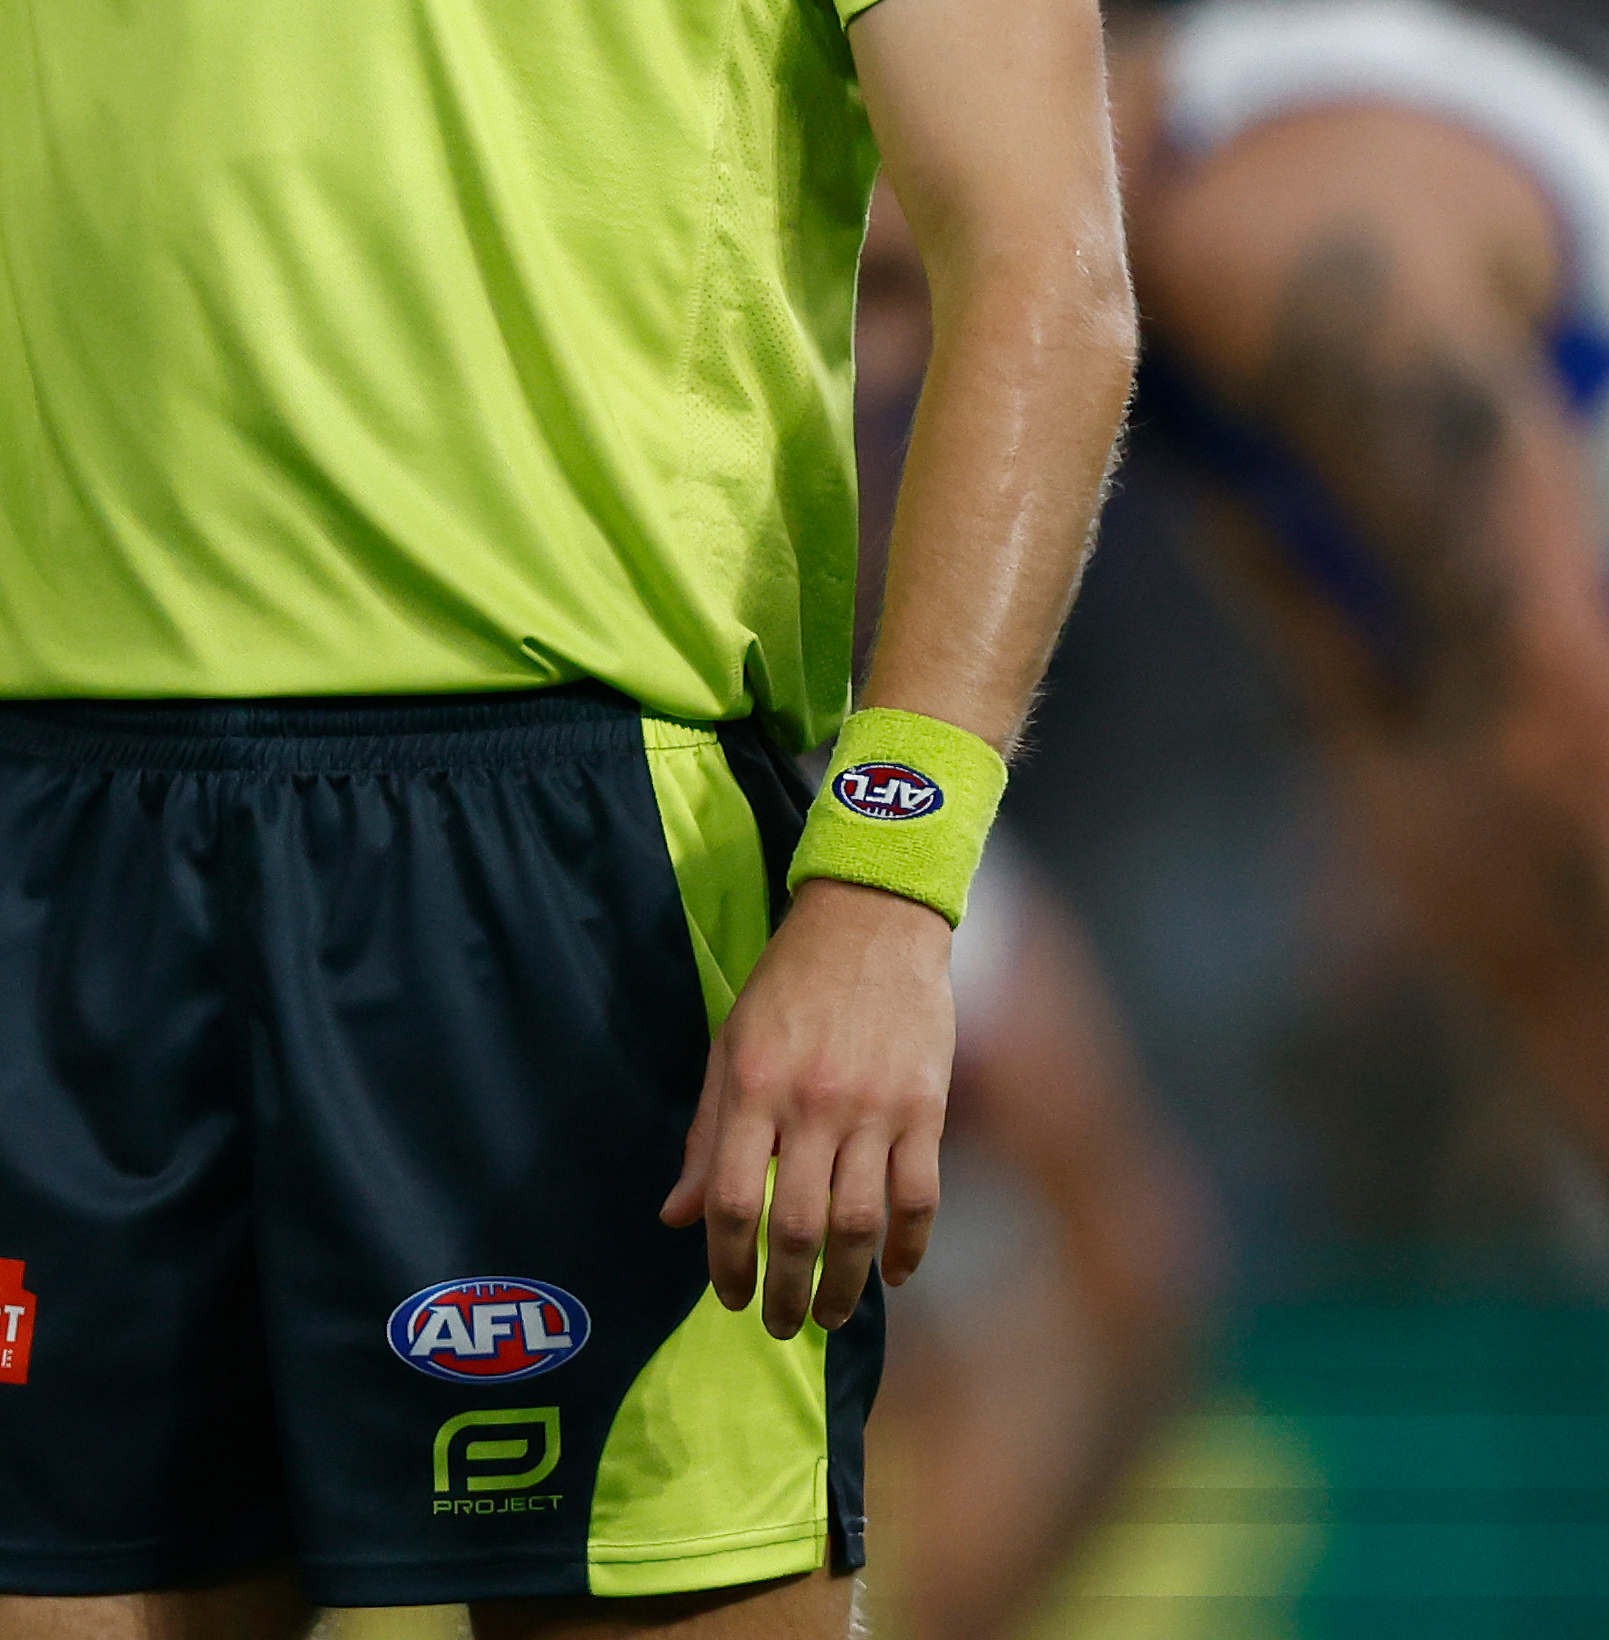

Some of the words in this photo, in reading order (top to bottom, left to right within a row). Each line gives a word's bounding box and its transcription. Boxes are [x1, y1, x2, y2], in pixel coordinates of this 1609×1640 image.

[843, 772, 937, 811] AFL
[409, 1302, 574, 1357] AFL
[432, 1494, 564, 1516] PROJECT
